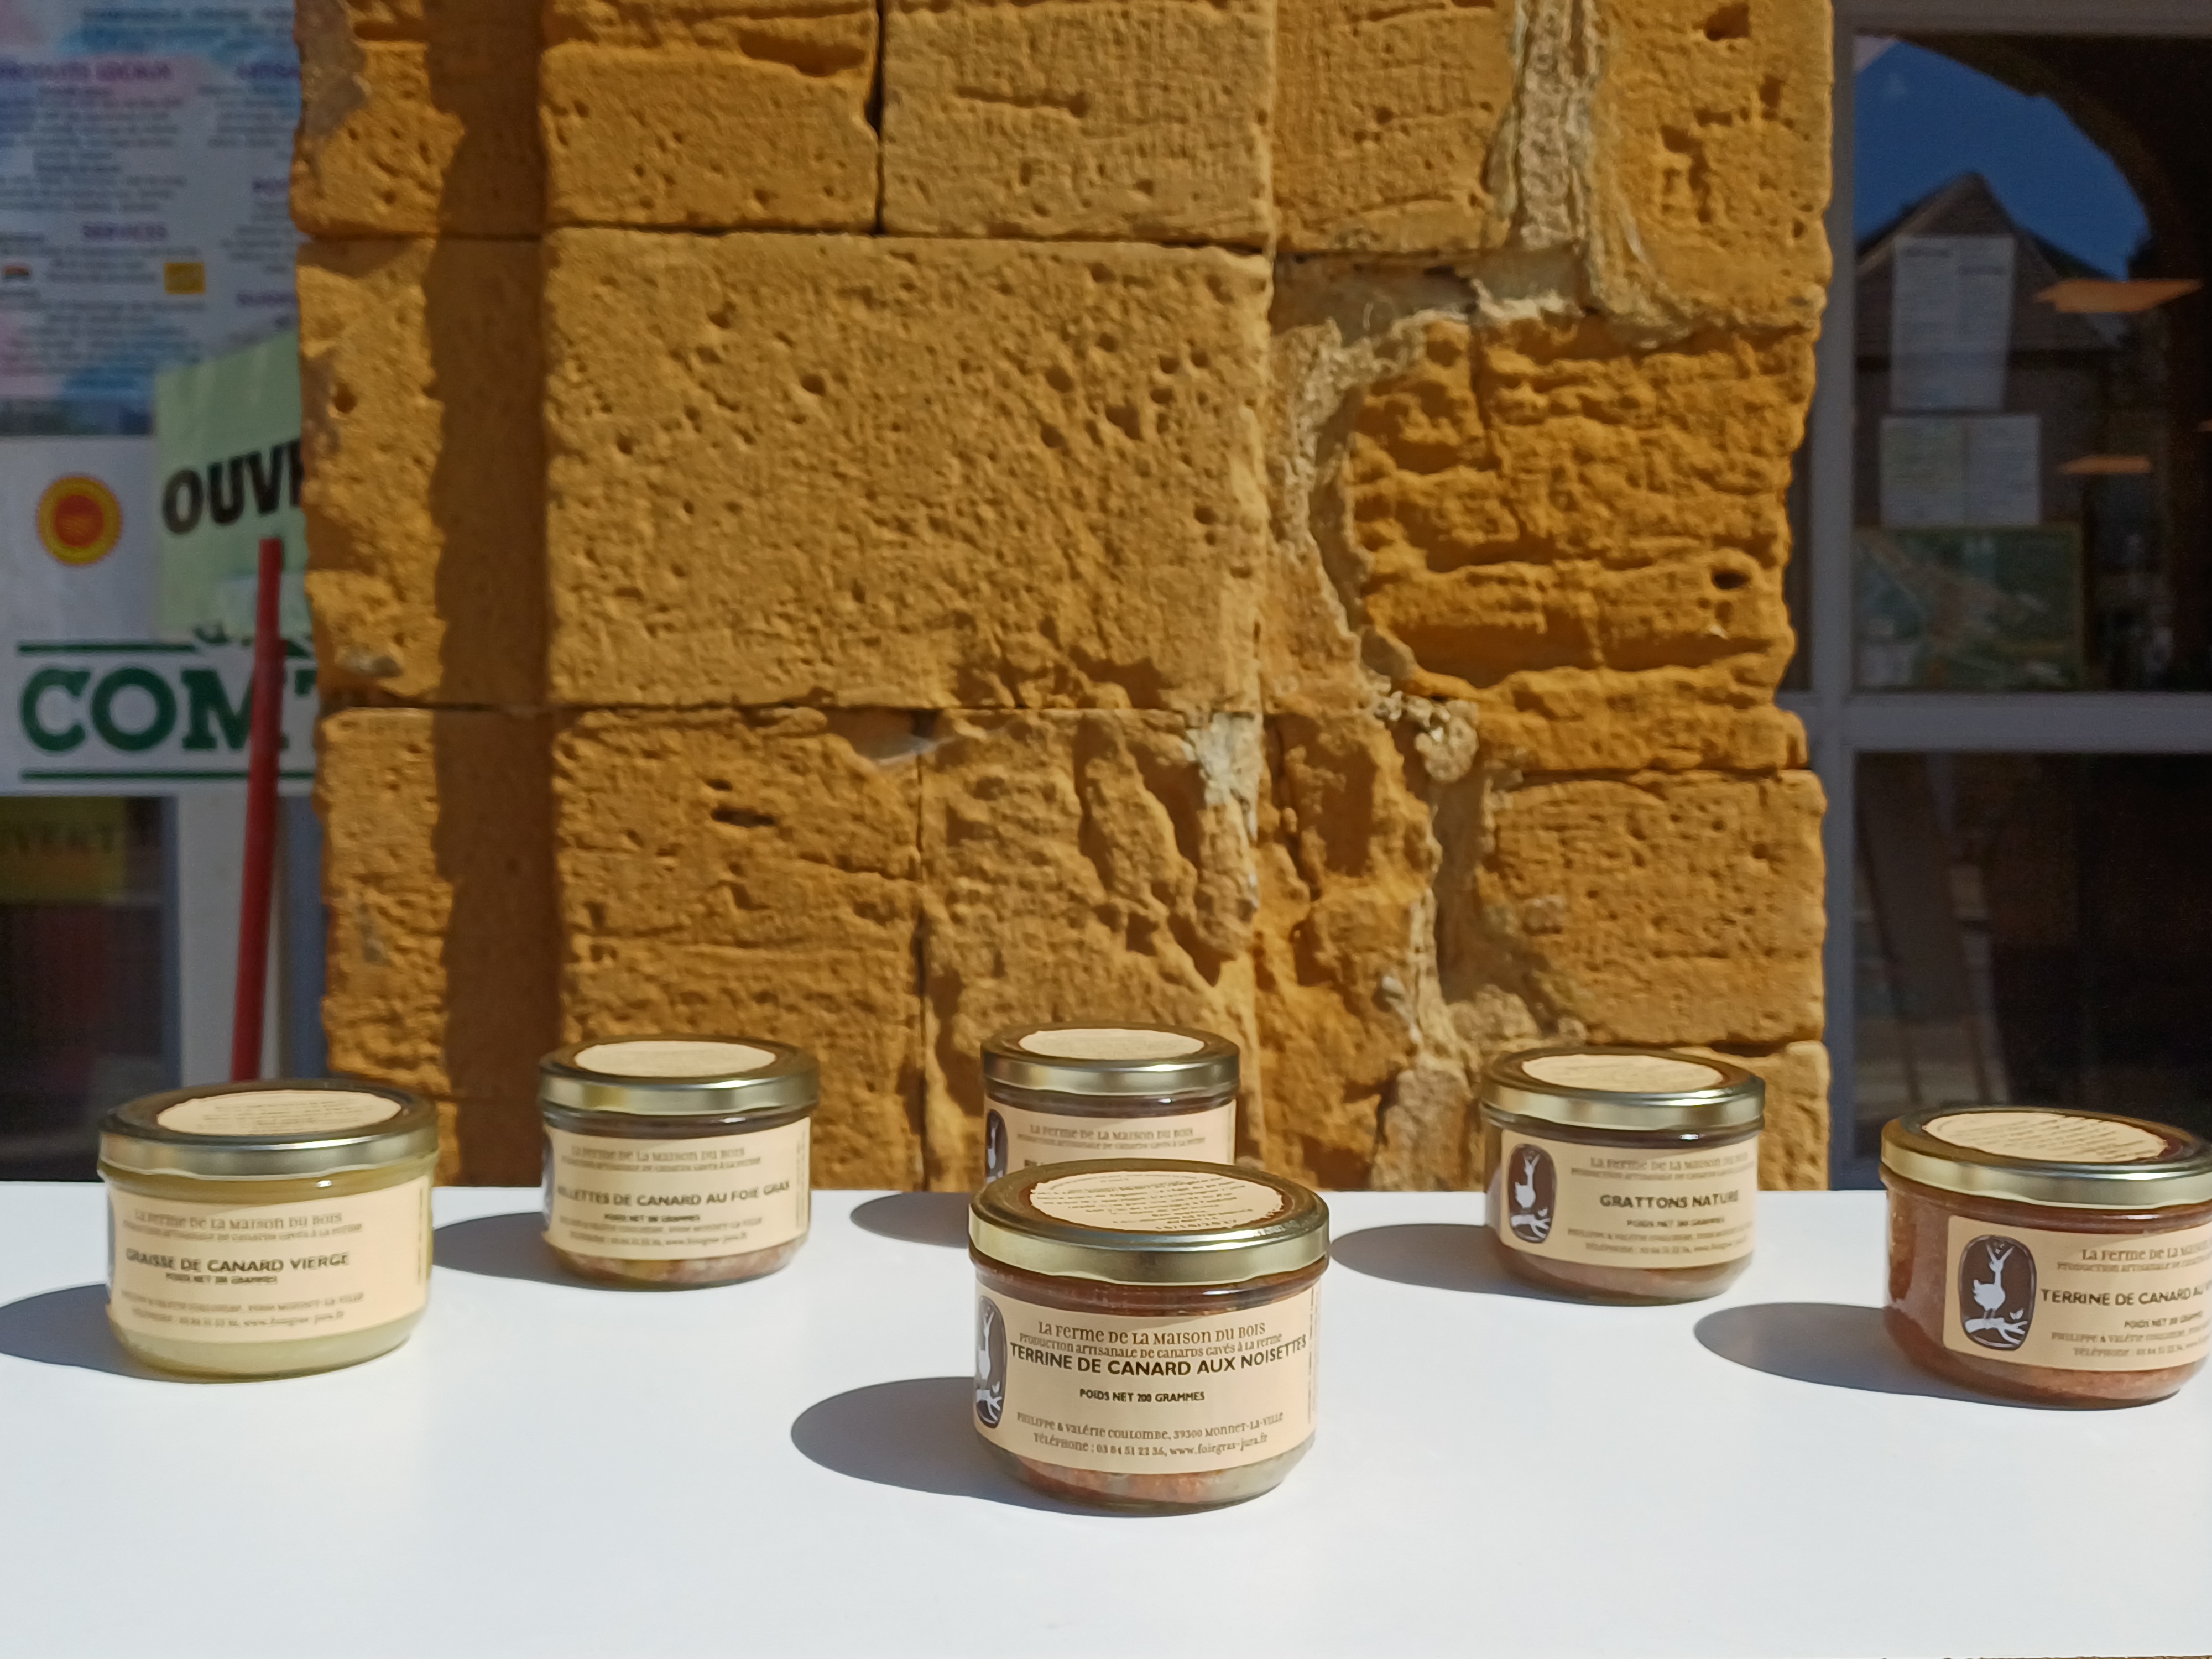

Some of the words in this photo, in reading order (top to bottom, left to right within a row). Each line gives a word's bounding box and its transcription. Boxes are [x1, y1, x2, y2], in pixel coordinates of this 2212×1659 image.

[613, 1193, 632, 1206] DE
[637, 1194, 701, 1206] CANARD
[706, 1193, 727, 1204] AU
[1600, 1194, 1687, 1209] GRATTONS
[181, 1258, 201, 1271] DE
[207, 1259, 284, 1272] CANARD
[290, 1252, 349, 1270] VIERGE
[2041, 1288, 2111, 1306] TERRINE
[2115, 1292, 2135, 1306] DE
[2138, 1288, 2191, 1304] CANARD
[1039, 1321, 1052, 1335] La
[1055, 1324, 1104, 1343] Ferme
[1153, 1331, 1211, 1345] Maison
[1010, 1342, 1072, 1370] TERRINE
[1078, 1357, 1101, 1373] DE
[1108, 1360, 1191, 1376] CANARD
[1197, 1357, 1236, 1374] AUX
[1241, 1334, 1306, 1369] NOISETTES
[1076, 1344, 1137, 1358] artisanale
[1157, 1347, 1203, 1358] canards
[1080, 1389, 1109, 1401] POIDS
[1113, 1392, 1134, 1402] NET
[1155, 1392, 1204, 1402] GRAMMES
[1065, 1424, 1105, 1437] Valérie
[1034, 1432, 1088, 1452] Téléphone
